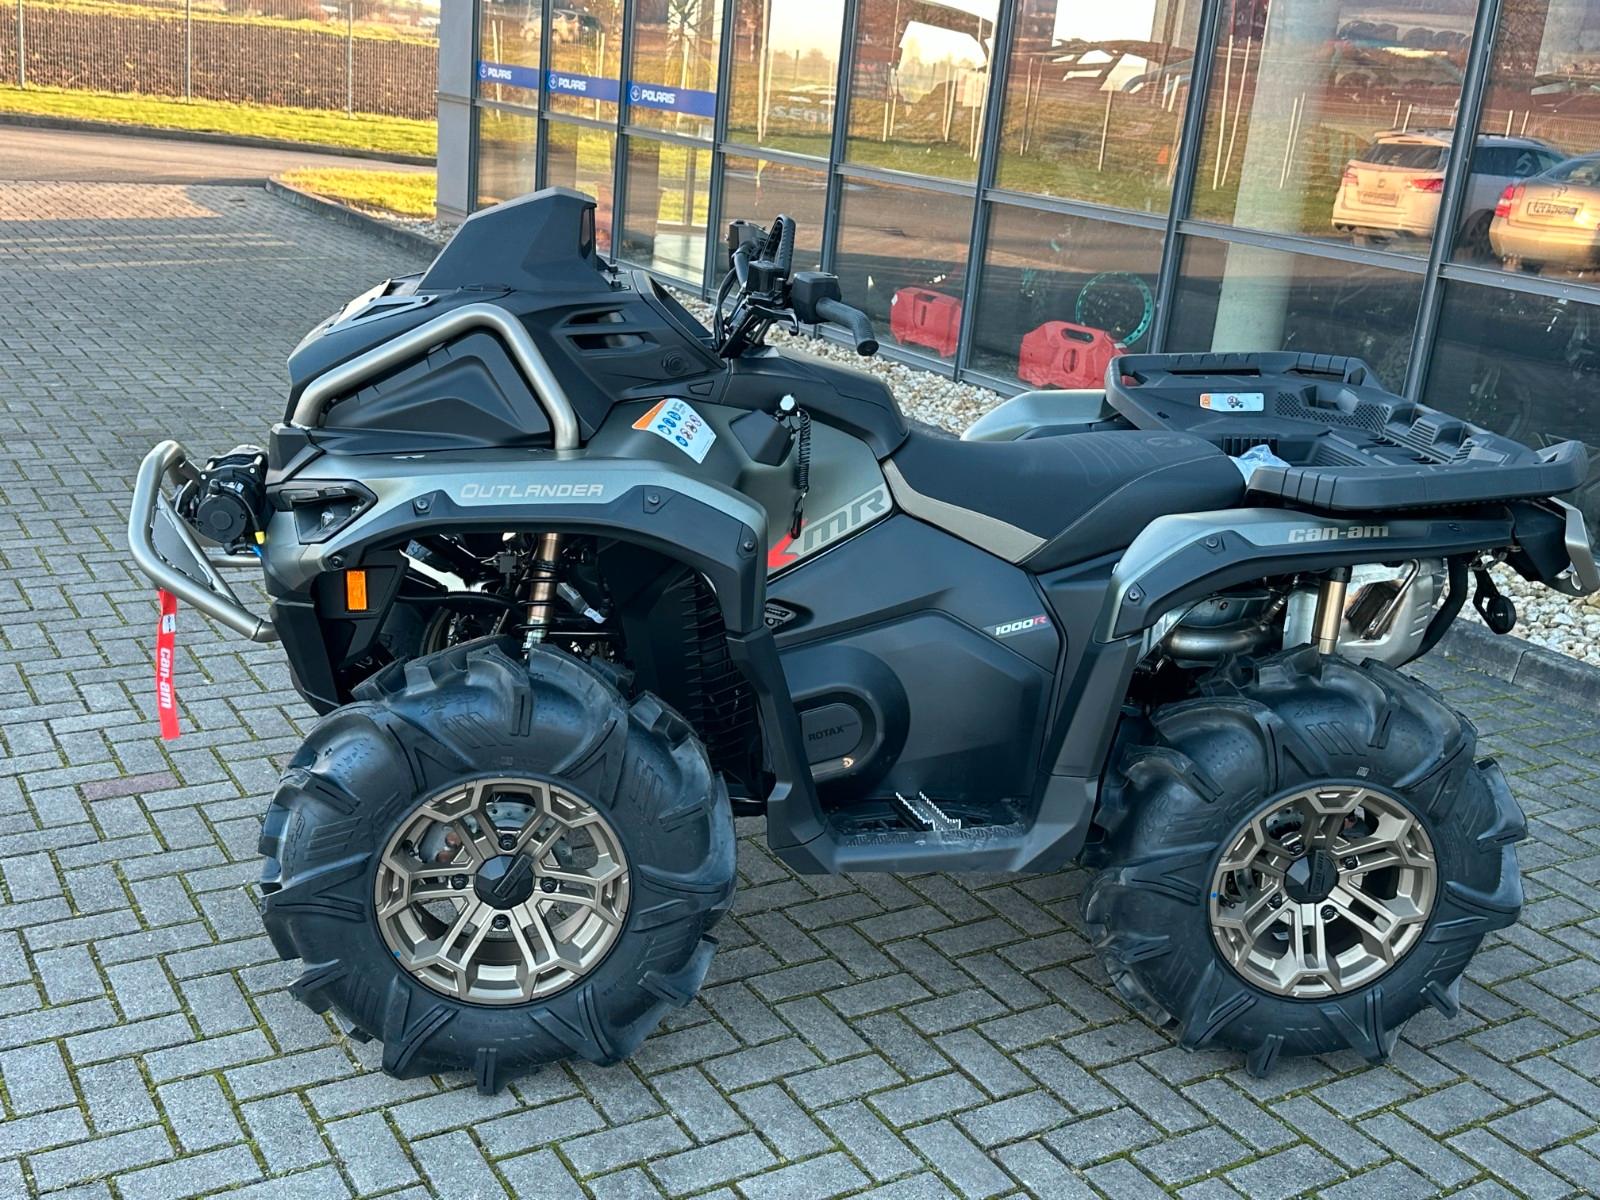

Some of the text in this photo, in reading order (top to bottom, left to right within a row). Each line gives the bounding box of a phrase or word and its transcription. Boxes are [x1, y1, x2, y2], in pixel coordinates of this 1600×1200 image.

[487, 66, 512, 80] POLARIS
[558, 77, 587, 91] POLARIS
[641, 88, 675, 105] POLARIS
[460, 483, 604, 499] OUTLANDER
[995, 615, 1047, 636] 1000R
[808, 724, 845, 741] ROTAX
